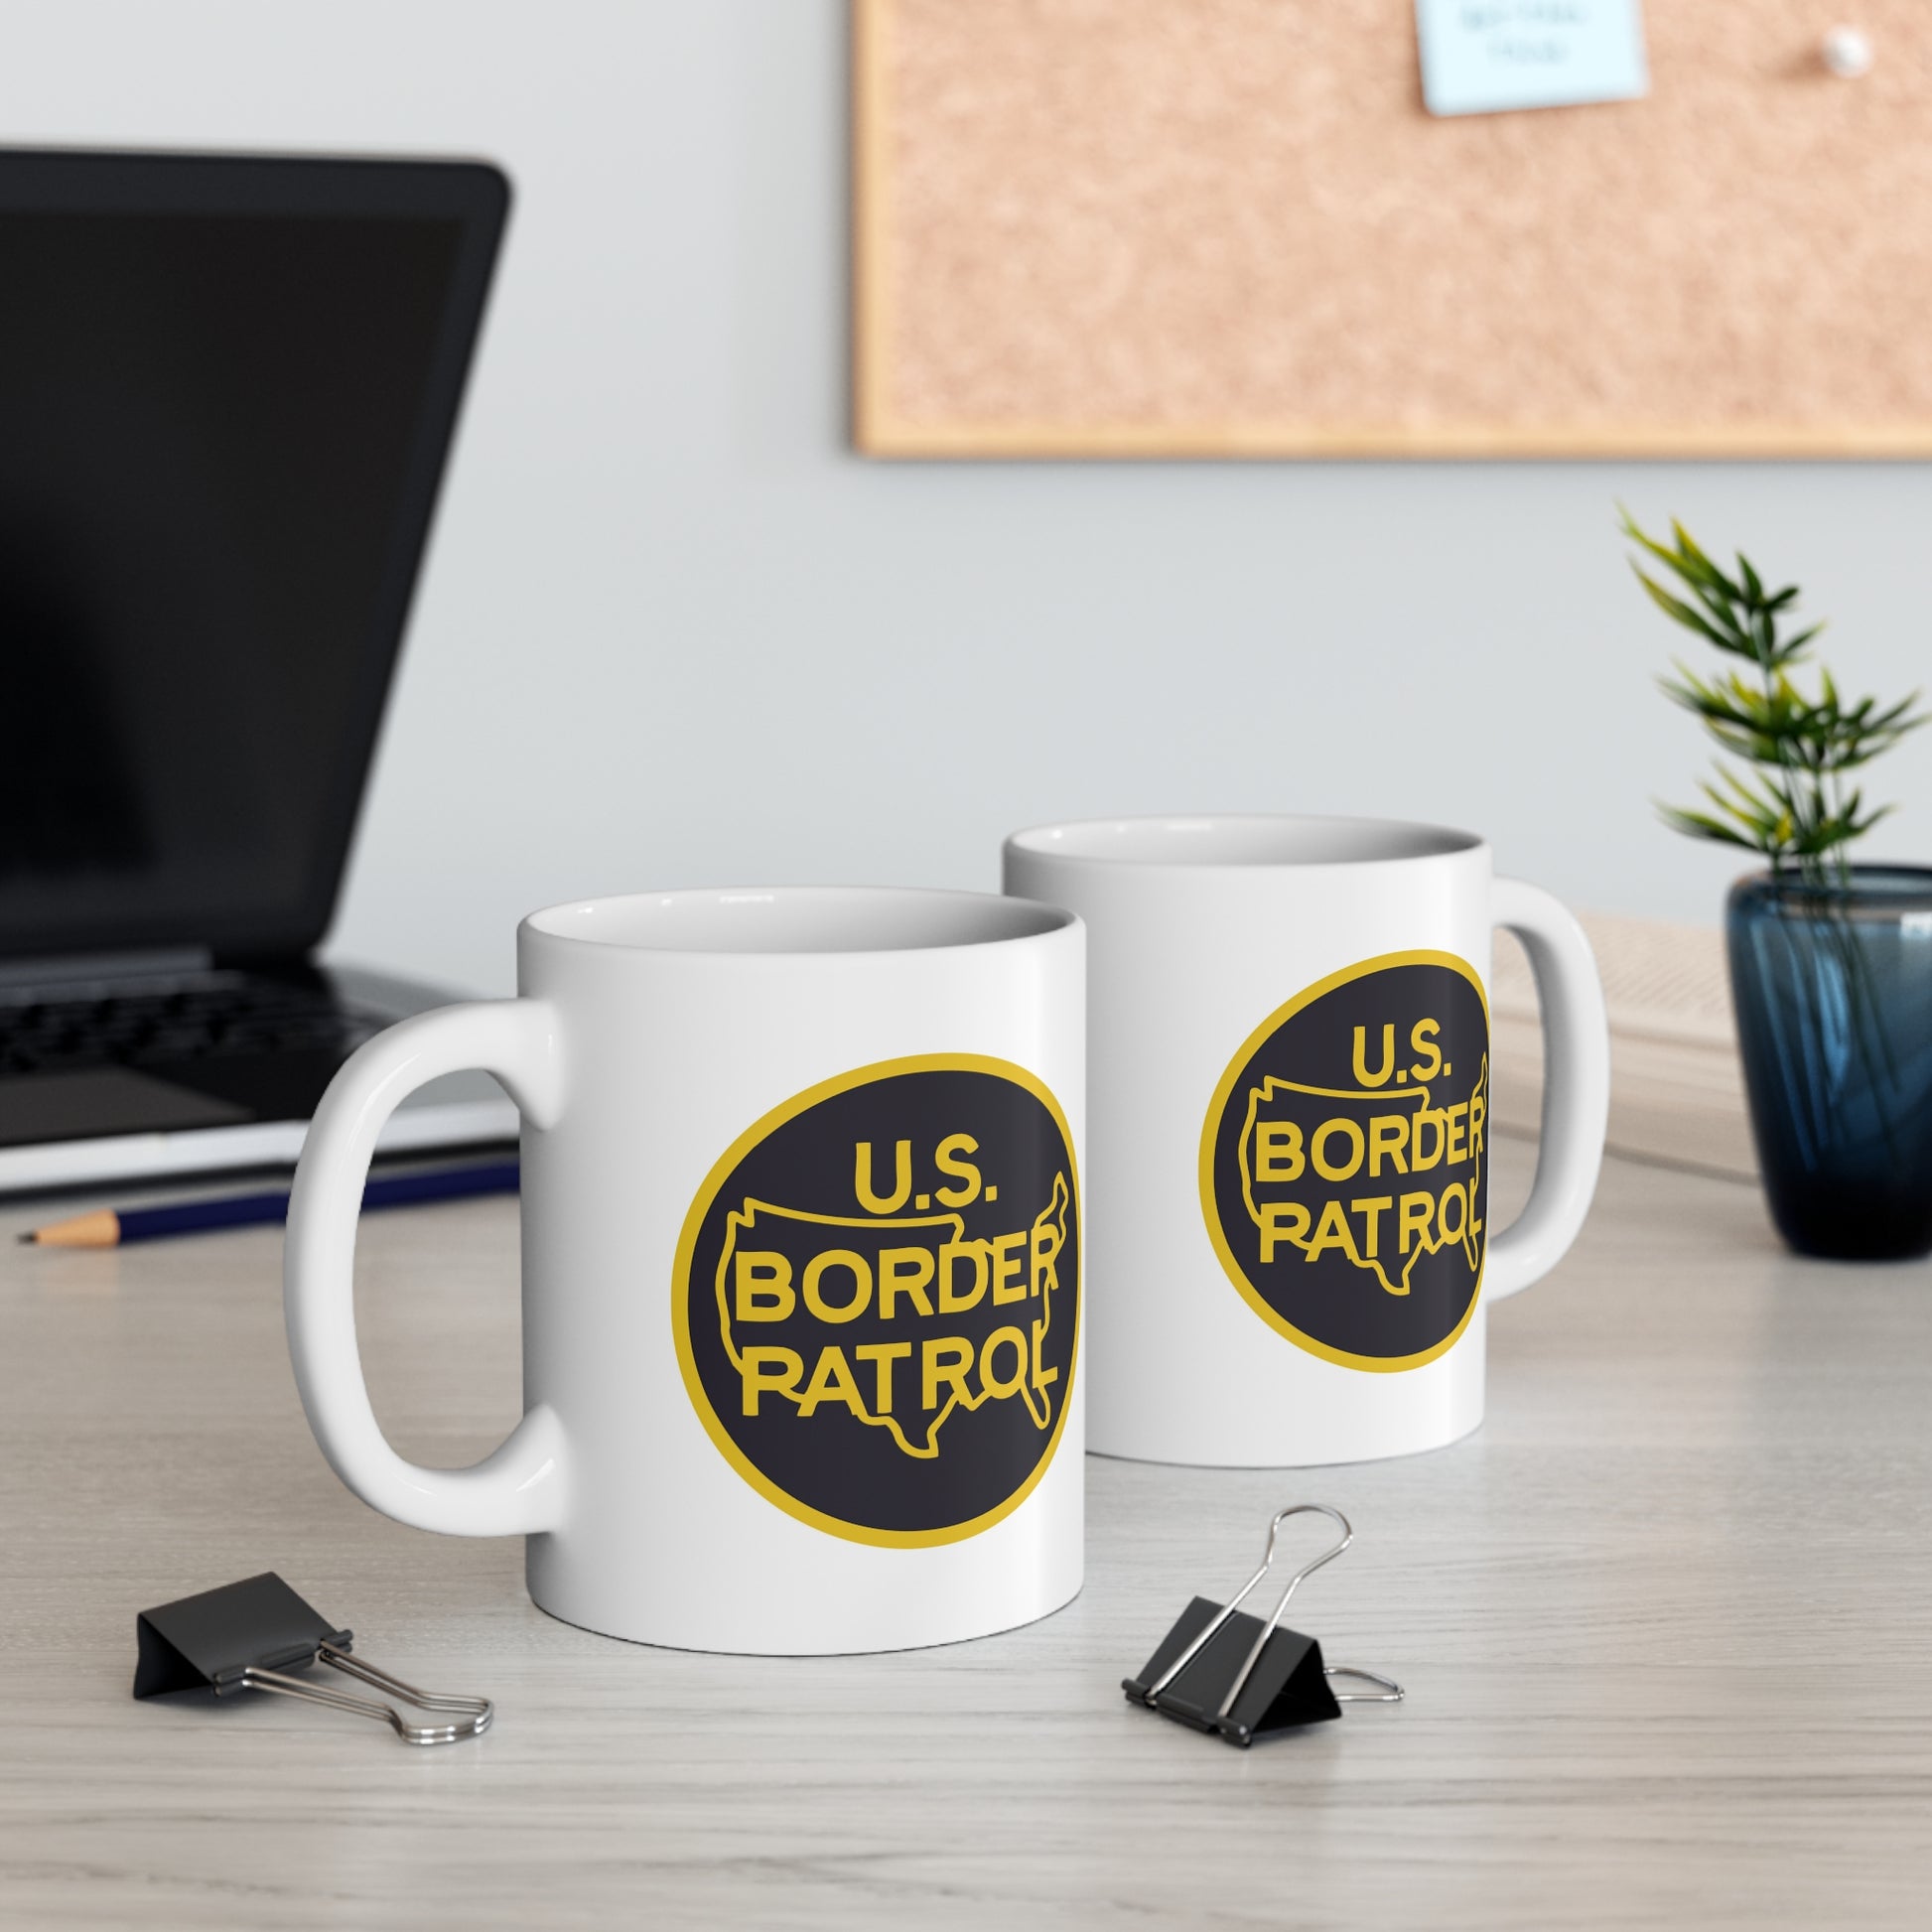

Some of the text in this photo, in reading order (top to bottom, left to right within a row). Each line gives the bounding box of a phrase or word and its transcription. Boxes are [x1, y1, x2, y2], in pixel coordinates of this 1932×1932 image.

[1352, 1018, 1452, 1088] U.S.
[855, 1133, 999, 1214] U.S.
[1255, 1095, 1483, 1182] BORDER
[1259, 1176, 1482, 1263] PATROL
[735, 1222, 1059, 1323] BORDER
[742, 1319, 1058, 1417] PATROL
